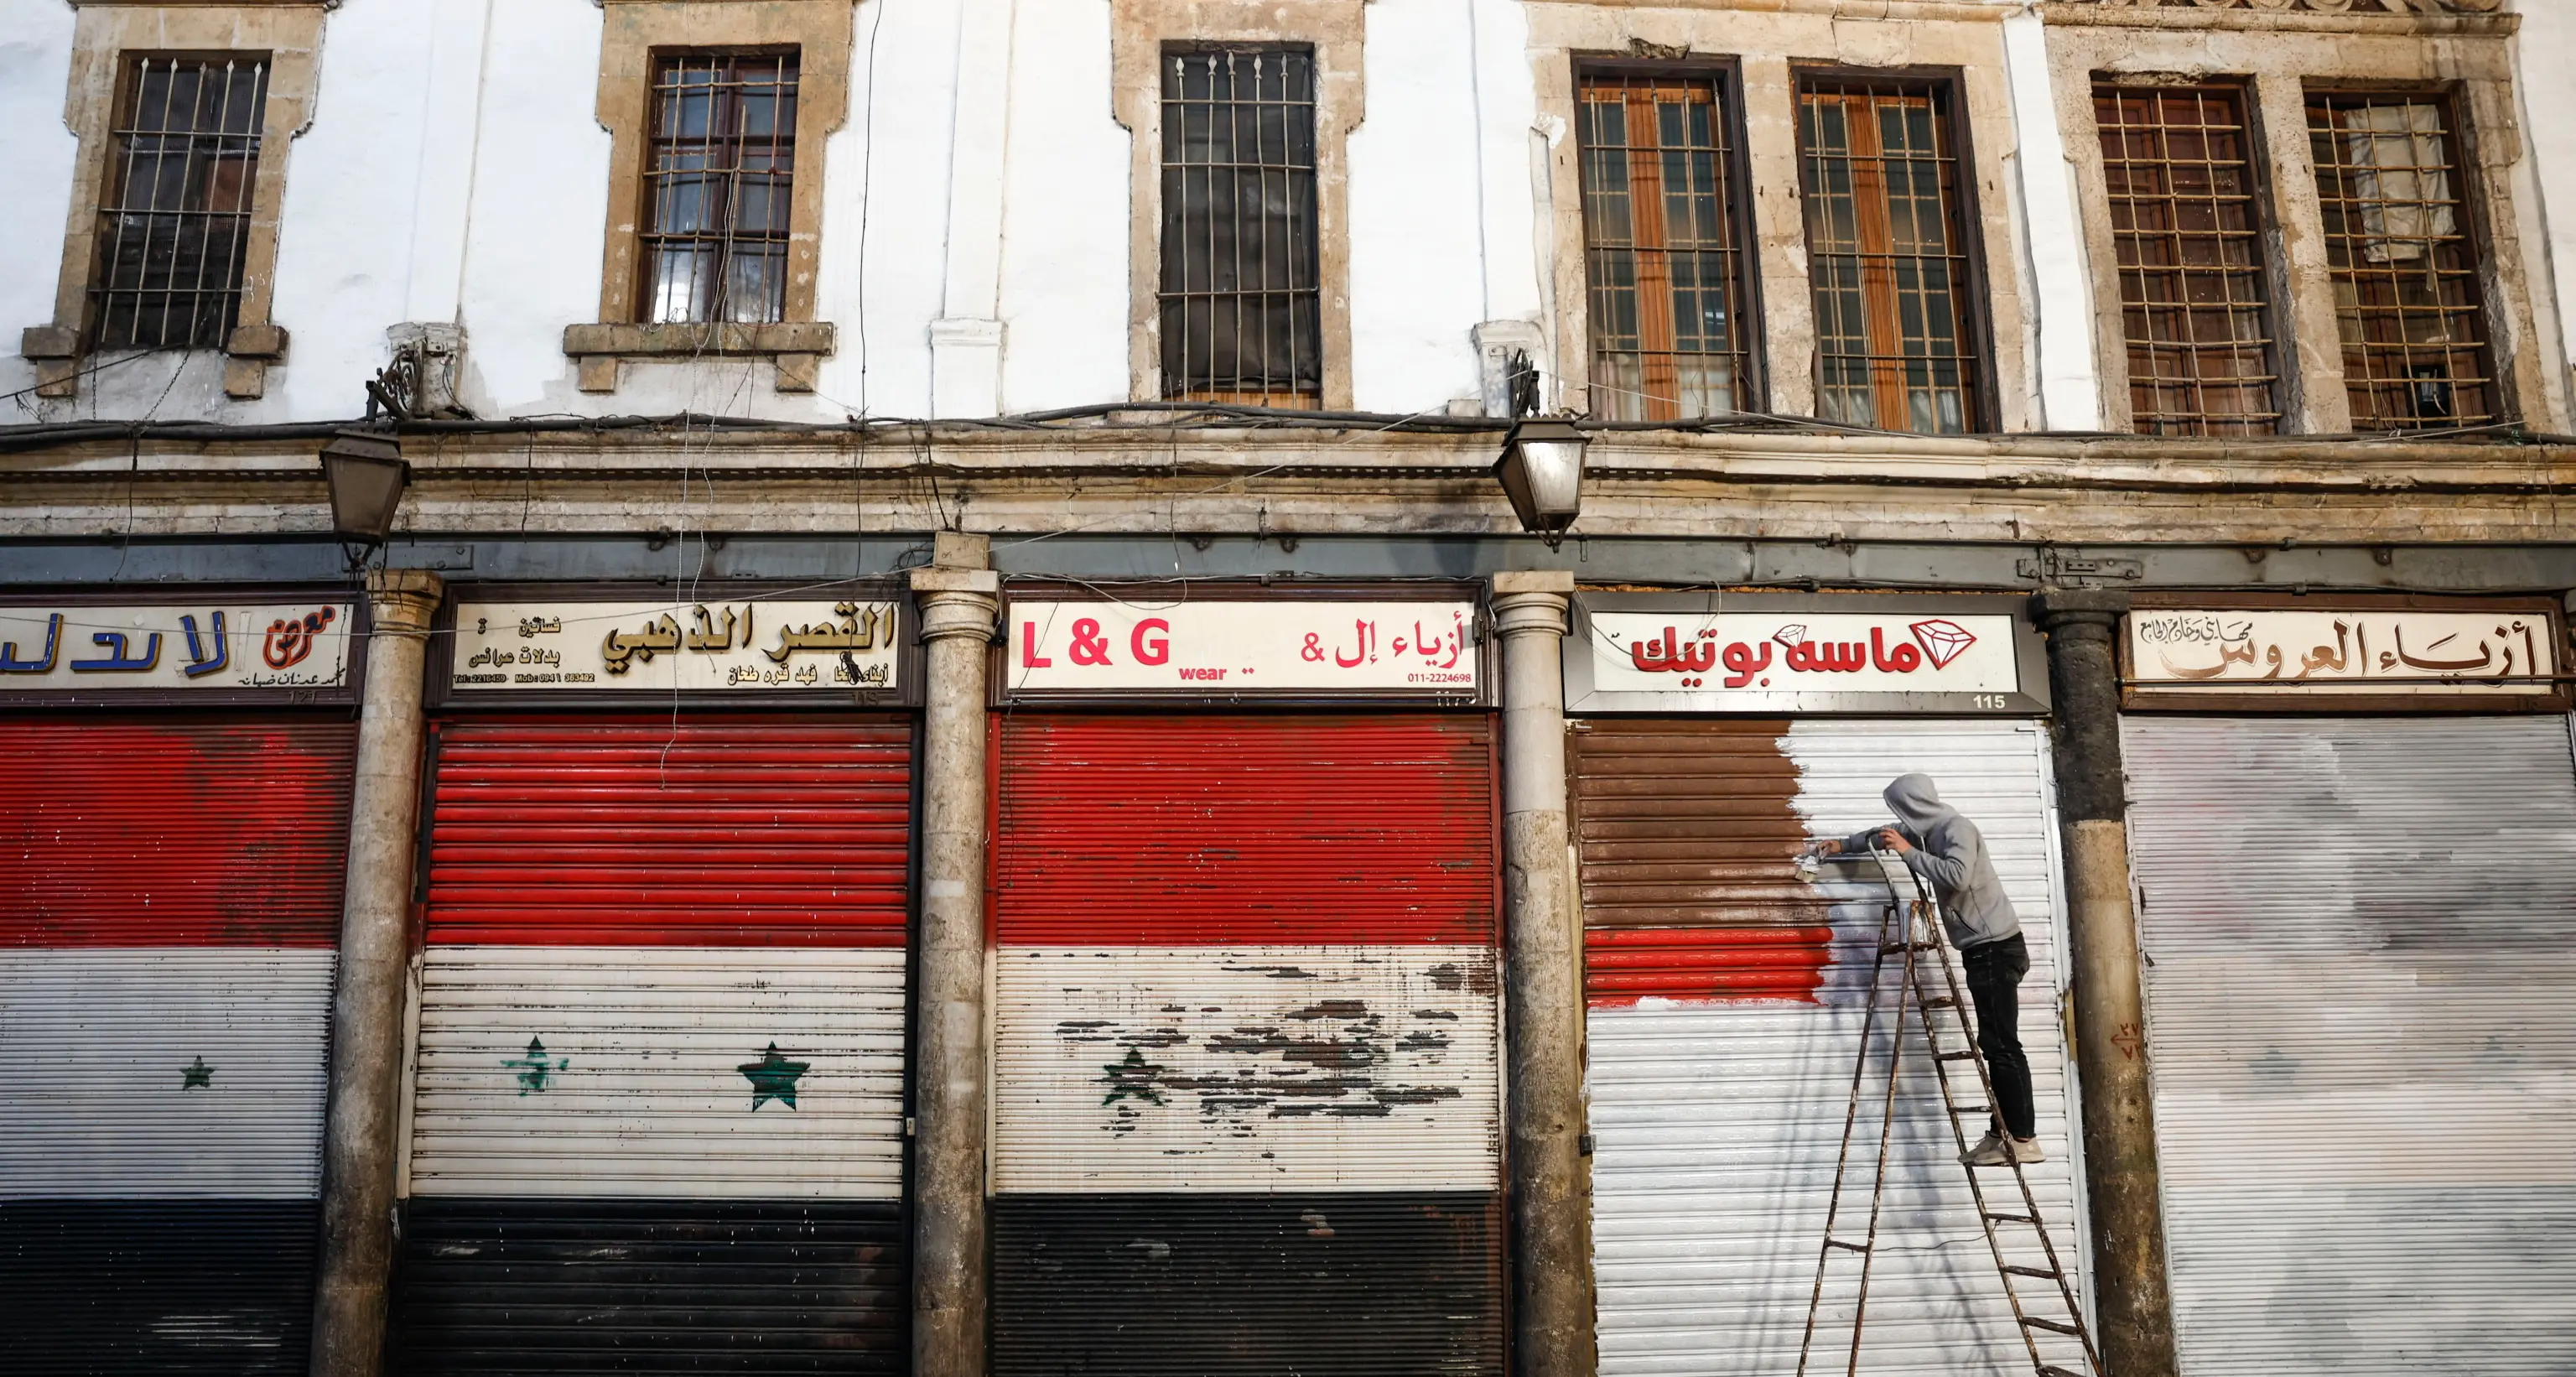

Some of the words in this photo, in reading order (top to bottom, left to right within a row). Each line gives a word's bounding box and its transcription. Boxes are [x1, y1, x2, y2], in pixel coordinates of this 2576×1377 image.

[518, 616, 561, 638] فساتين
[601, 602, 753, 674] الذهبي
[761, 601, 895, 663] القصر
[1023, 621, 1052, 668] L
[1068, 618, 1114, 666] &
[1130, 618, 1169, 666] G
[1301, 631, 1326, 662] &
[1335, 618, 1378, 668] إل
[1392, 611, 1464, 668] أزياء
[518, 646, 561, 668] بدلات
[1631, 626, 1772, 688] بوتيك
[2158, 617, 2369, 686] العروس
[2379, 621, 2538, 687] أزياء
[276, 672, 319, 685] عدنان
[795, 663, 818, 685] فهد
[1178, 668, 1228, 680] wear
[1408, 673, 1472, 682] 011-2224698
[1973, 694, 2006, 709] 115
